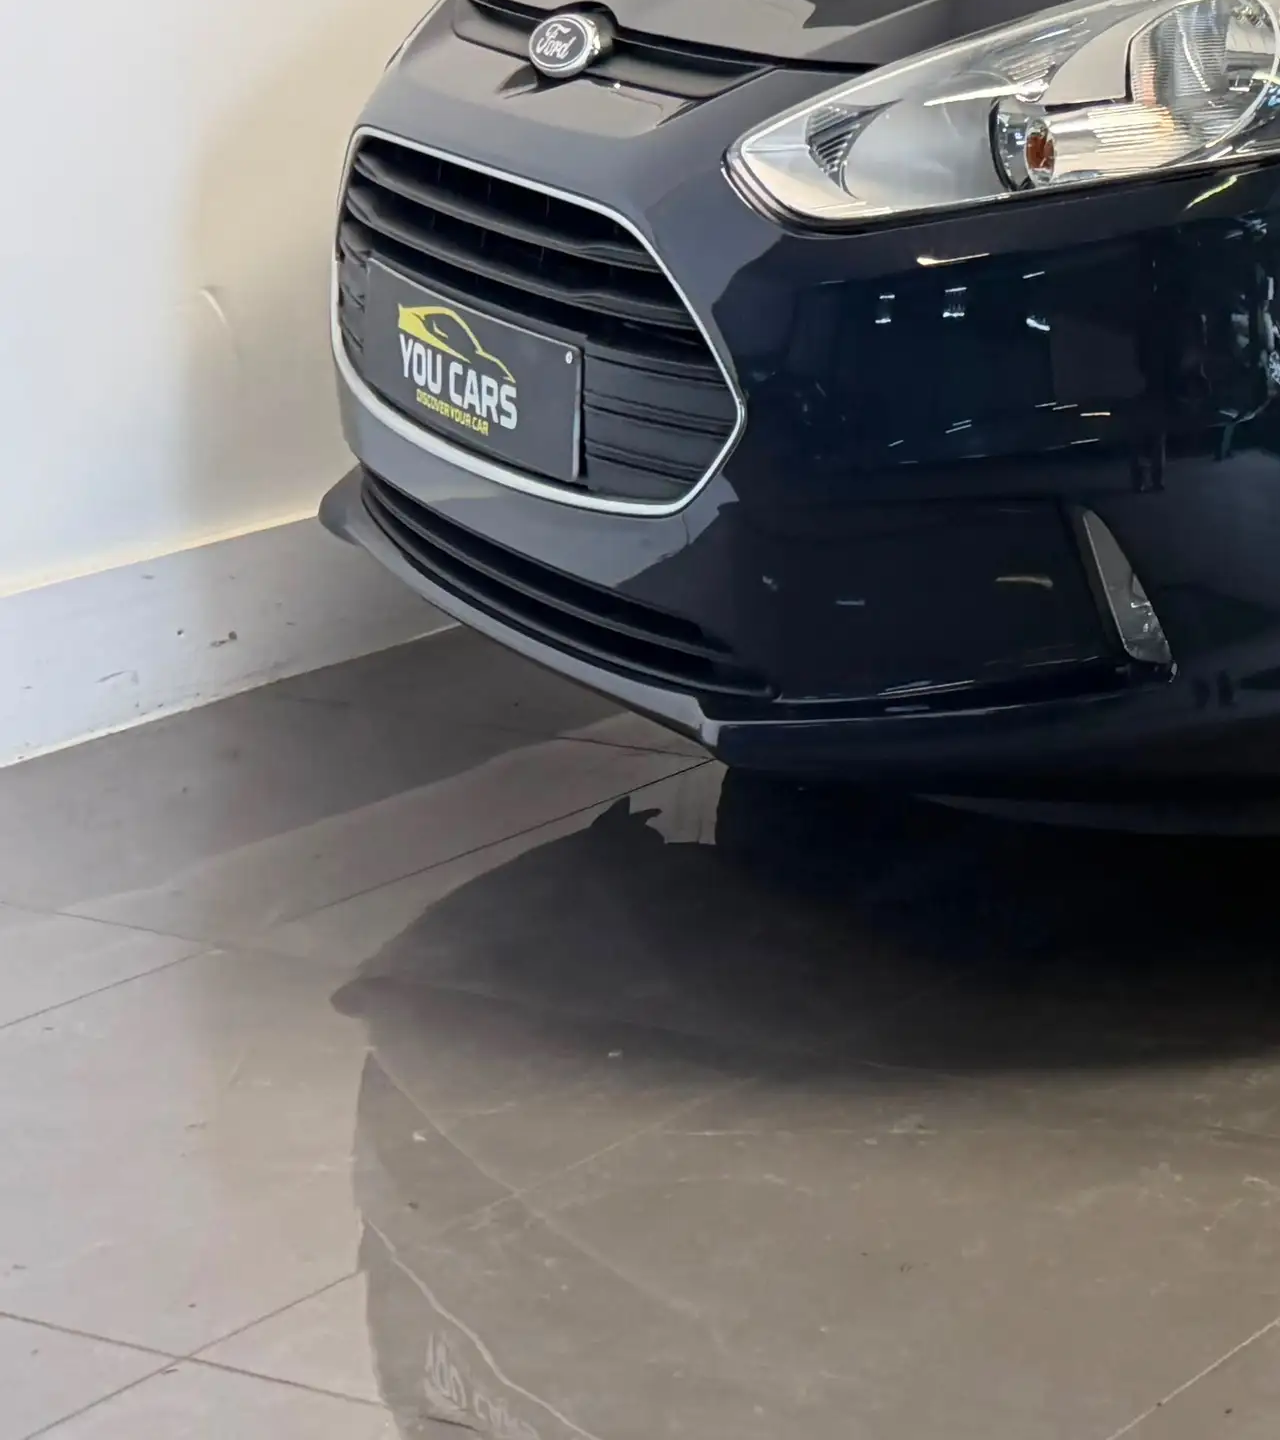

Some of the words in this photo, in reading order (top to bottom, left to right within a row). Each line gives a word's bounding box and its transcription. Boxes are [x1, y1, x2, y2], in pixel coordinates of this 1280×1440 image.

[536, 23, 577, 59] Ford
[400, 333, 442, 395] YOU
[449, 361, 518, 430] CARS
[416, 388, 450, 417] DISCOVER
[450, 408, 472, 428] YOUR
[472, 417, 489, 436] CAR
